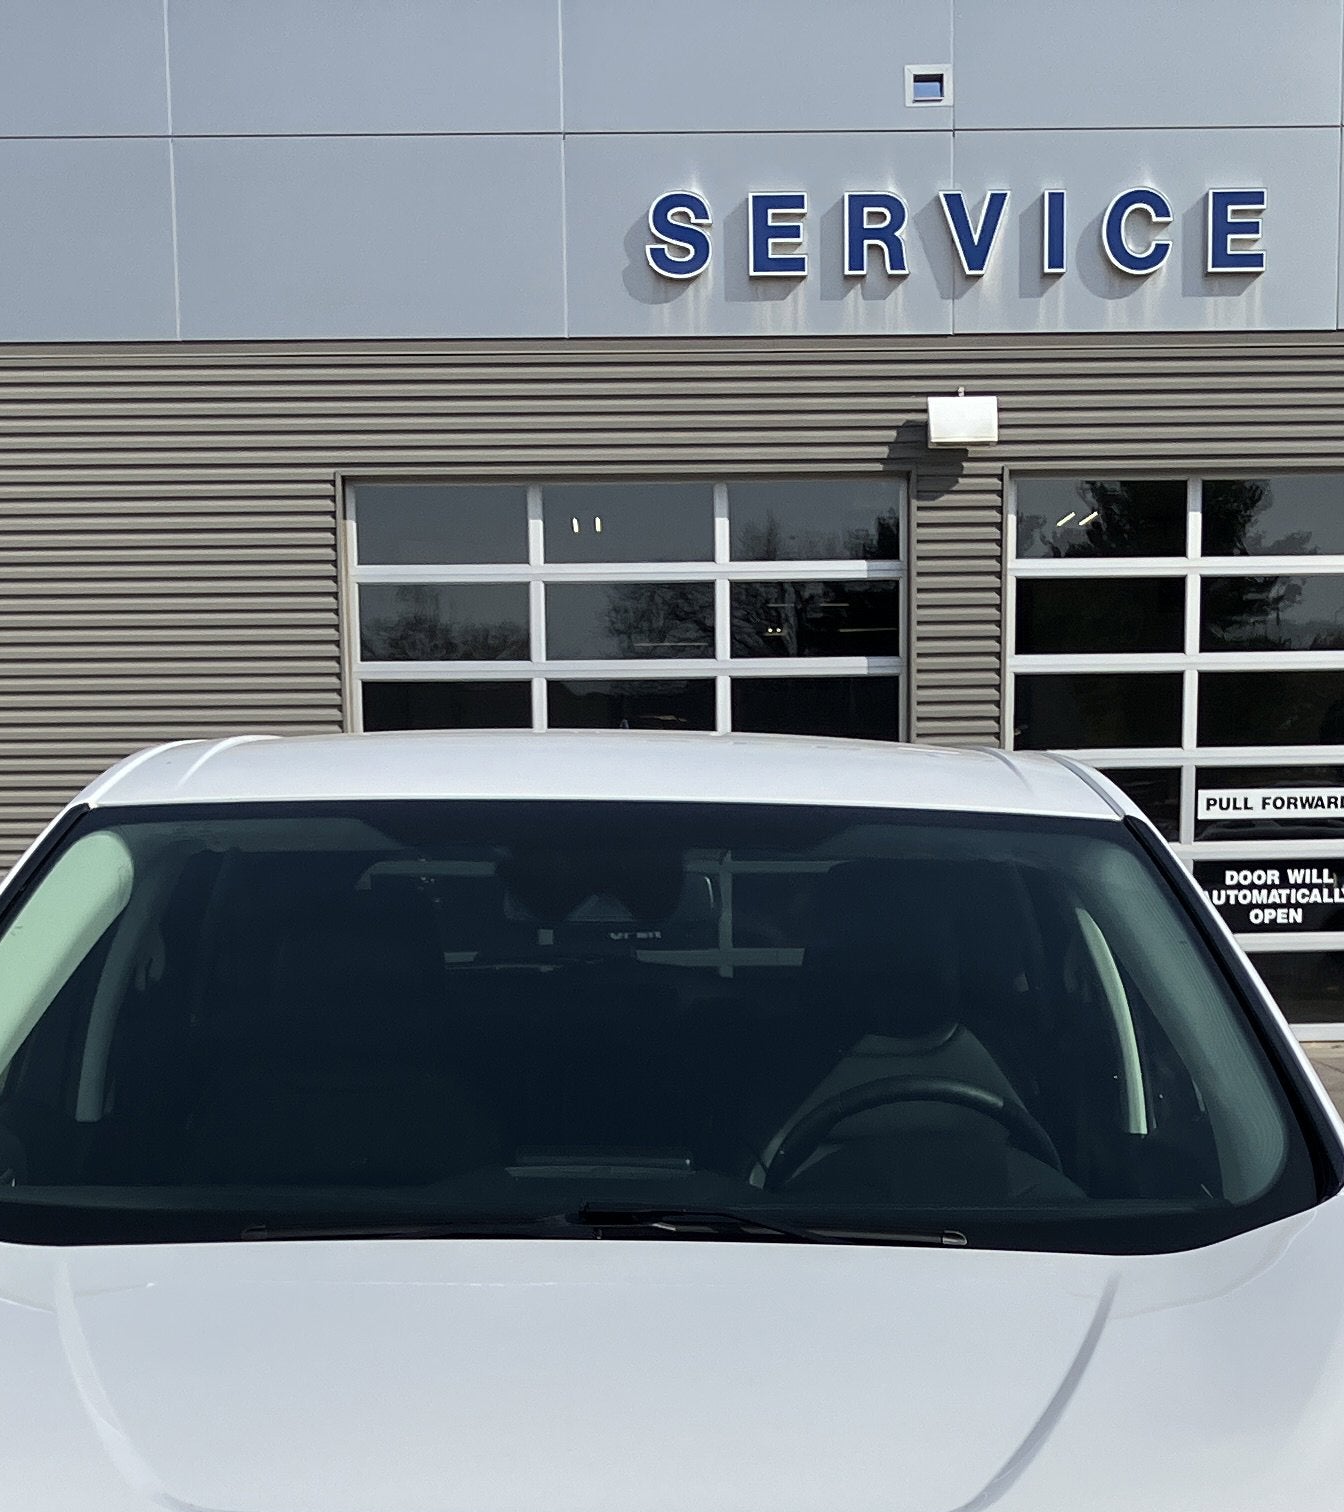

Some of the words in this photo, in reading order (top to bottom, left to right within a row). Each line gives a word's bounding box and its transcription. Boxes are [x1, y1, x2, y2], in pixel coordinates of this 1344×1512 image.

[644, 186, 1269, 281] SERVICE
[1205, 797, 1254, 812] PULL
[1225, 869, 1280, 886] DOOR
[1286, 868, 1335, 885] WILL
[1249, 908, 1303, 925] OPEN
